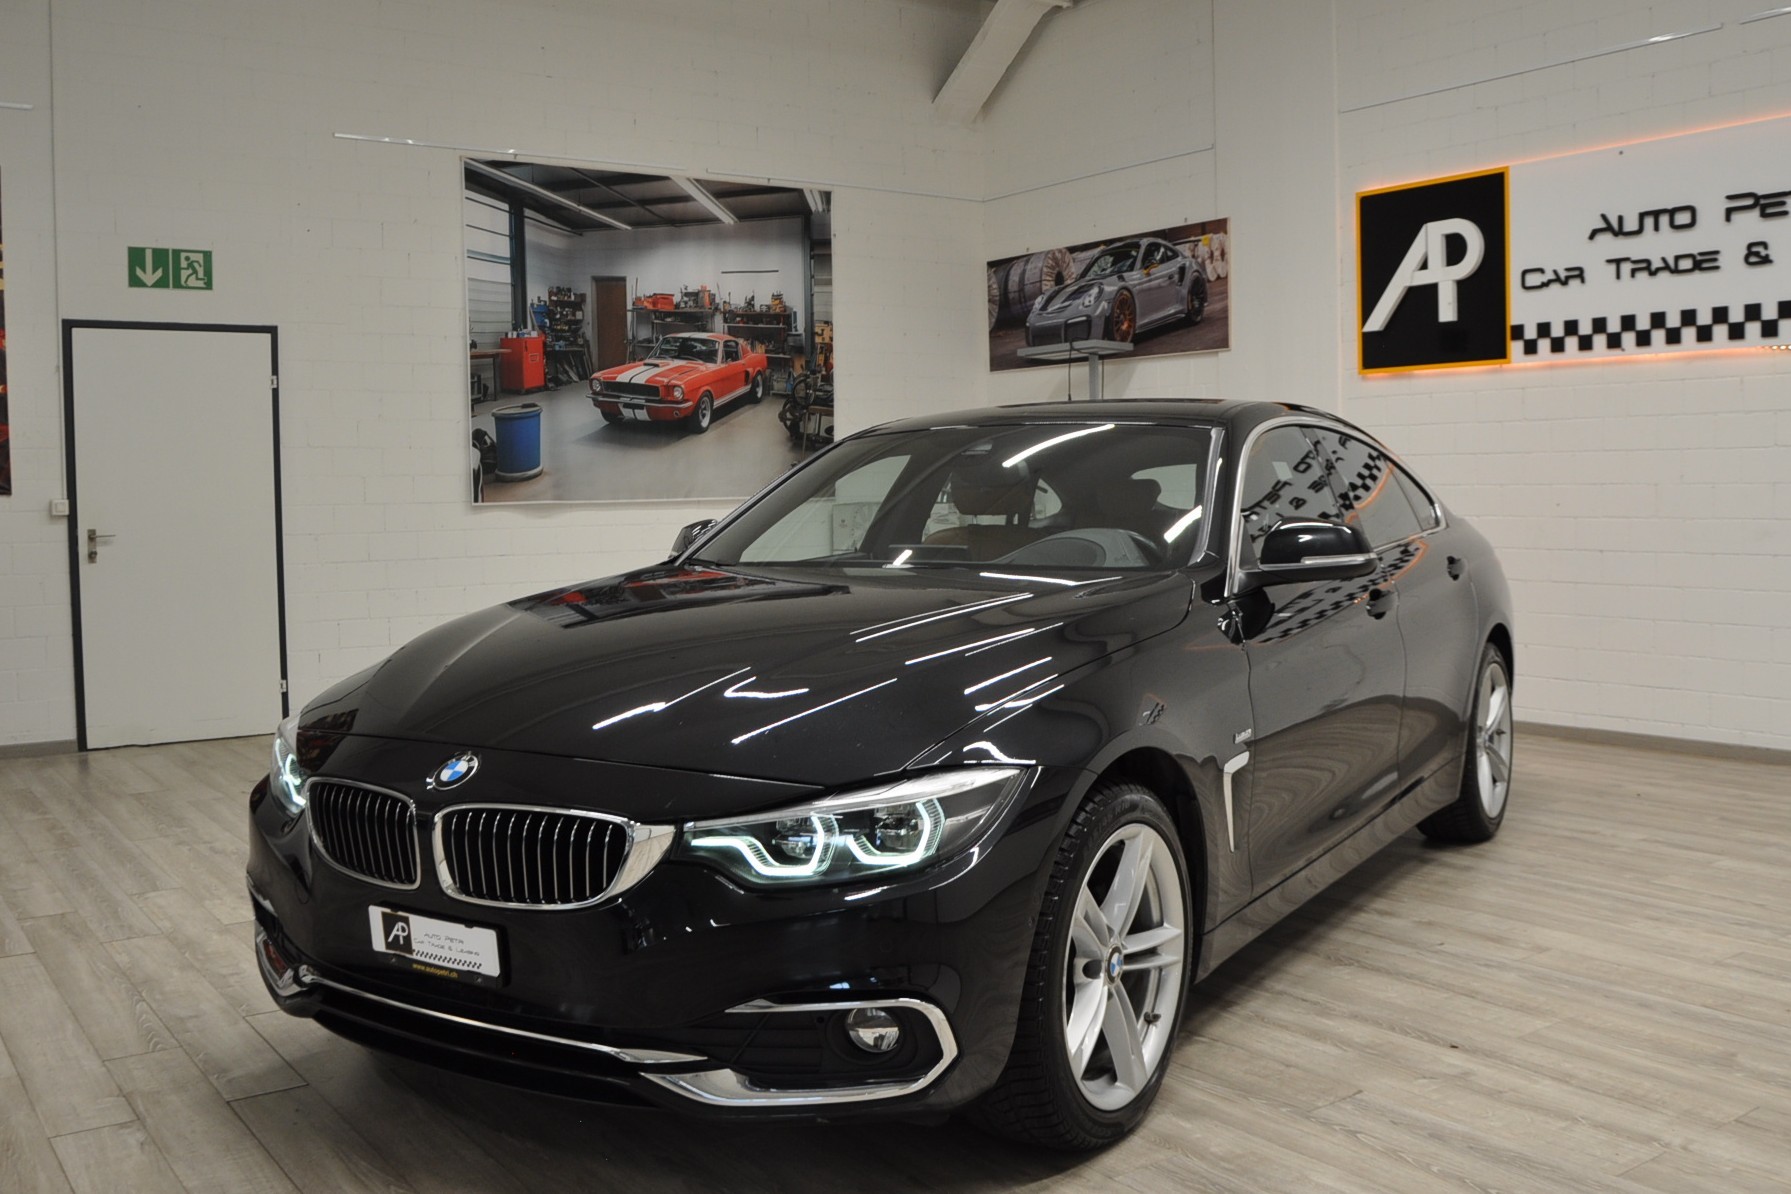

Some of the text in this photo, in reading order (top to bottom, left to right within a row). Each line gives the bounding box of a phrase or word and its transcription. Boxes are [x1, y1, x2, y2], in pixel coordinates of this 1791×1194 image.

[1588, 191, 1791, 240] AUTO PE
[1521, 241, 1774, 290] CAR TRADE &
